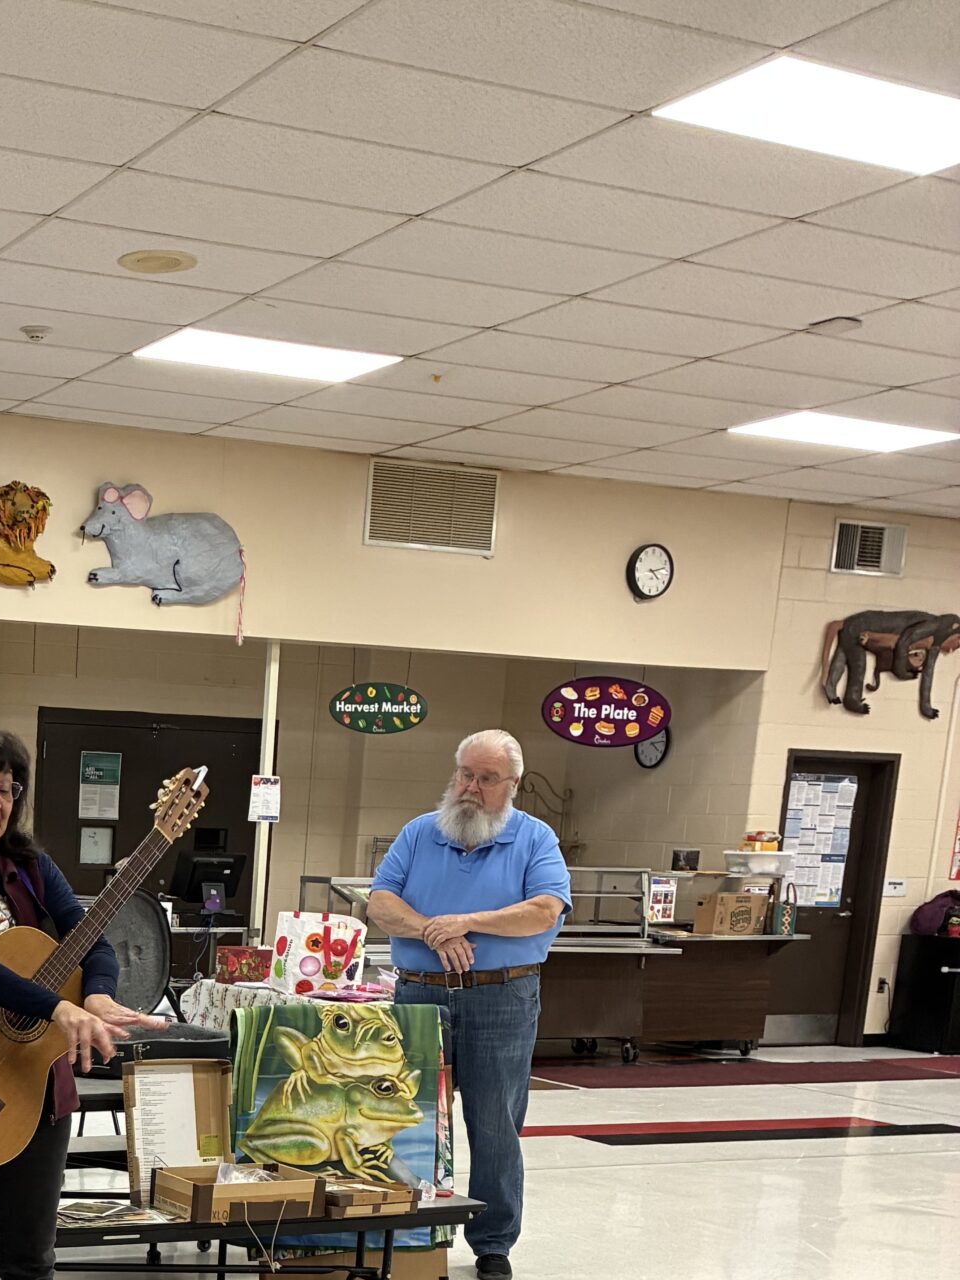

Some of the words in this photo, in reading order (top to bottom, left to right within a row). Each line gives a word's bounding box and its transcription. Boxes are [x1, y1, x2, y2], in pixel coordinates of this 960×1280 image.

[336, 701, 379, 712] Harvest
[382, 702, 421, 713] Market
[573, 702, 597, 718] The
[601, 704, 637, 720] Plate
